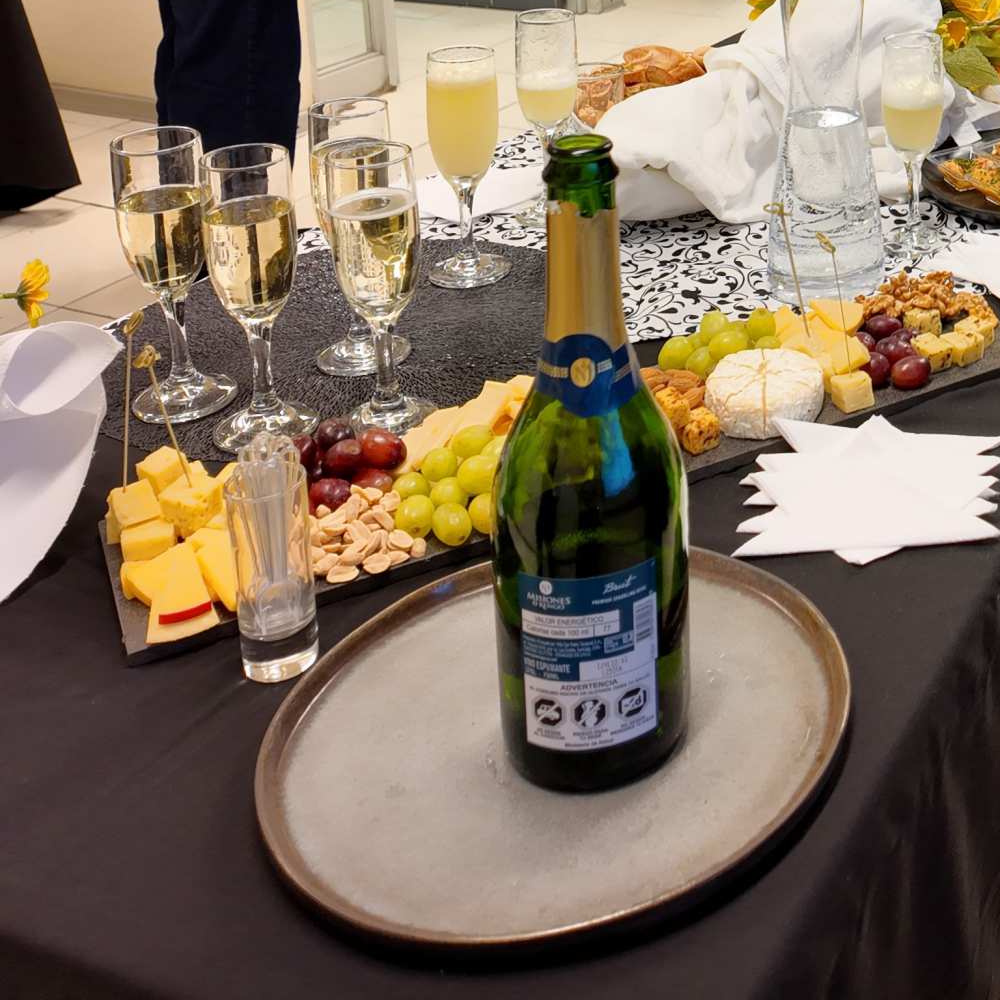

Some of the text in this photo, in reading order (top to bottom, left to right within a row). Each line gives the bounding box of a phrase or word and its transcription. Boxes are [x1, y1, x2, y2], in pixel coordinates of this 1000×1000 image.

[602, 575, 637, 595] Brut
[534, 614, 604, 626] VALOR ENERGÉTICO
[561, 678, 618, 692] ADVERTENCIA
